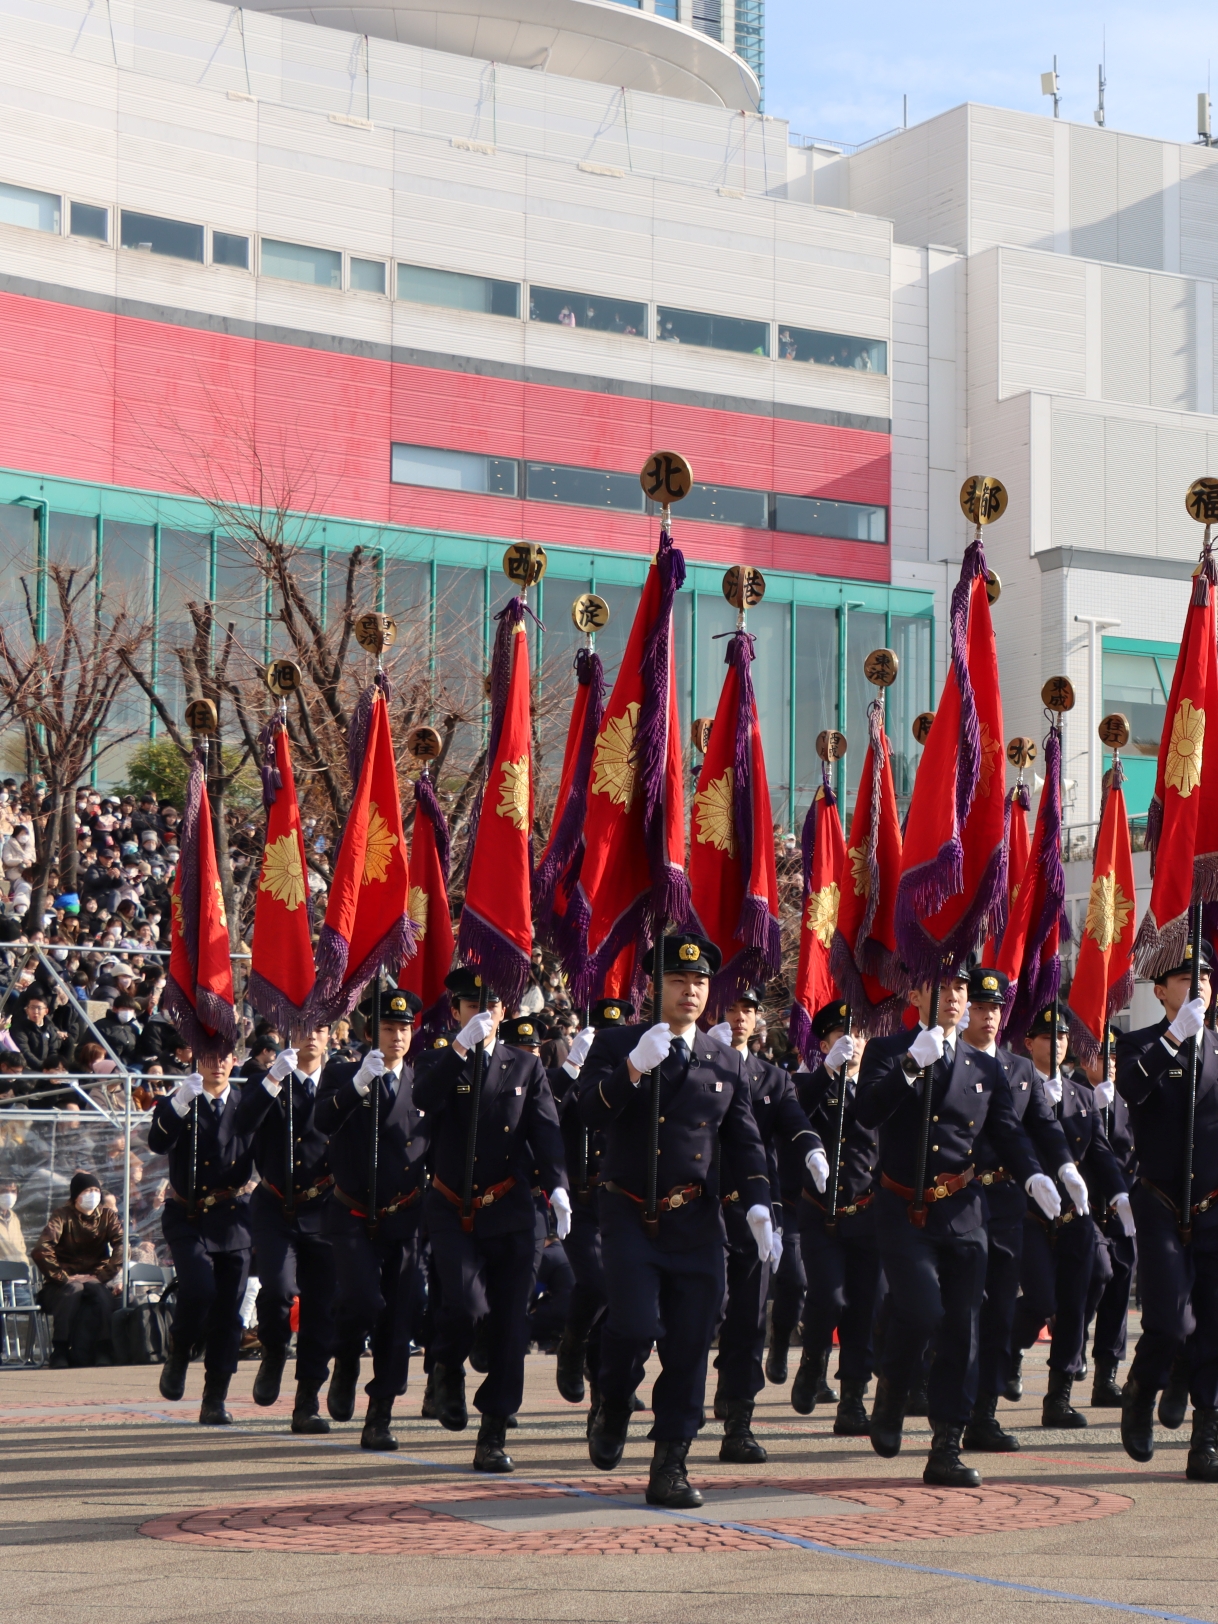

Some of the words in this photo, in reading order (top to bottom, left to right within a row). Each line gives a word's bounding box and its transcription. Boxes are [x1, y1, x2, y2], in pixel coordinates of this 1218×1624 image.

[647, 456, 684, 497] 北
[508, 547, 530, 581] 西
[580, 599, 604, 627] 淀
[270, 663, 296, 691] 旭
[869, 654, 891, 684] 東淀
[1049, 677, 1070, 710] 東成
[188, 701, 212, 730] 住
[413, 730, 436, 756] 東住
[1103, 718, 1125, 745] 住江
[1009, 738, 1036, 765] 水
